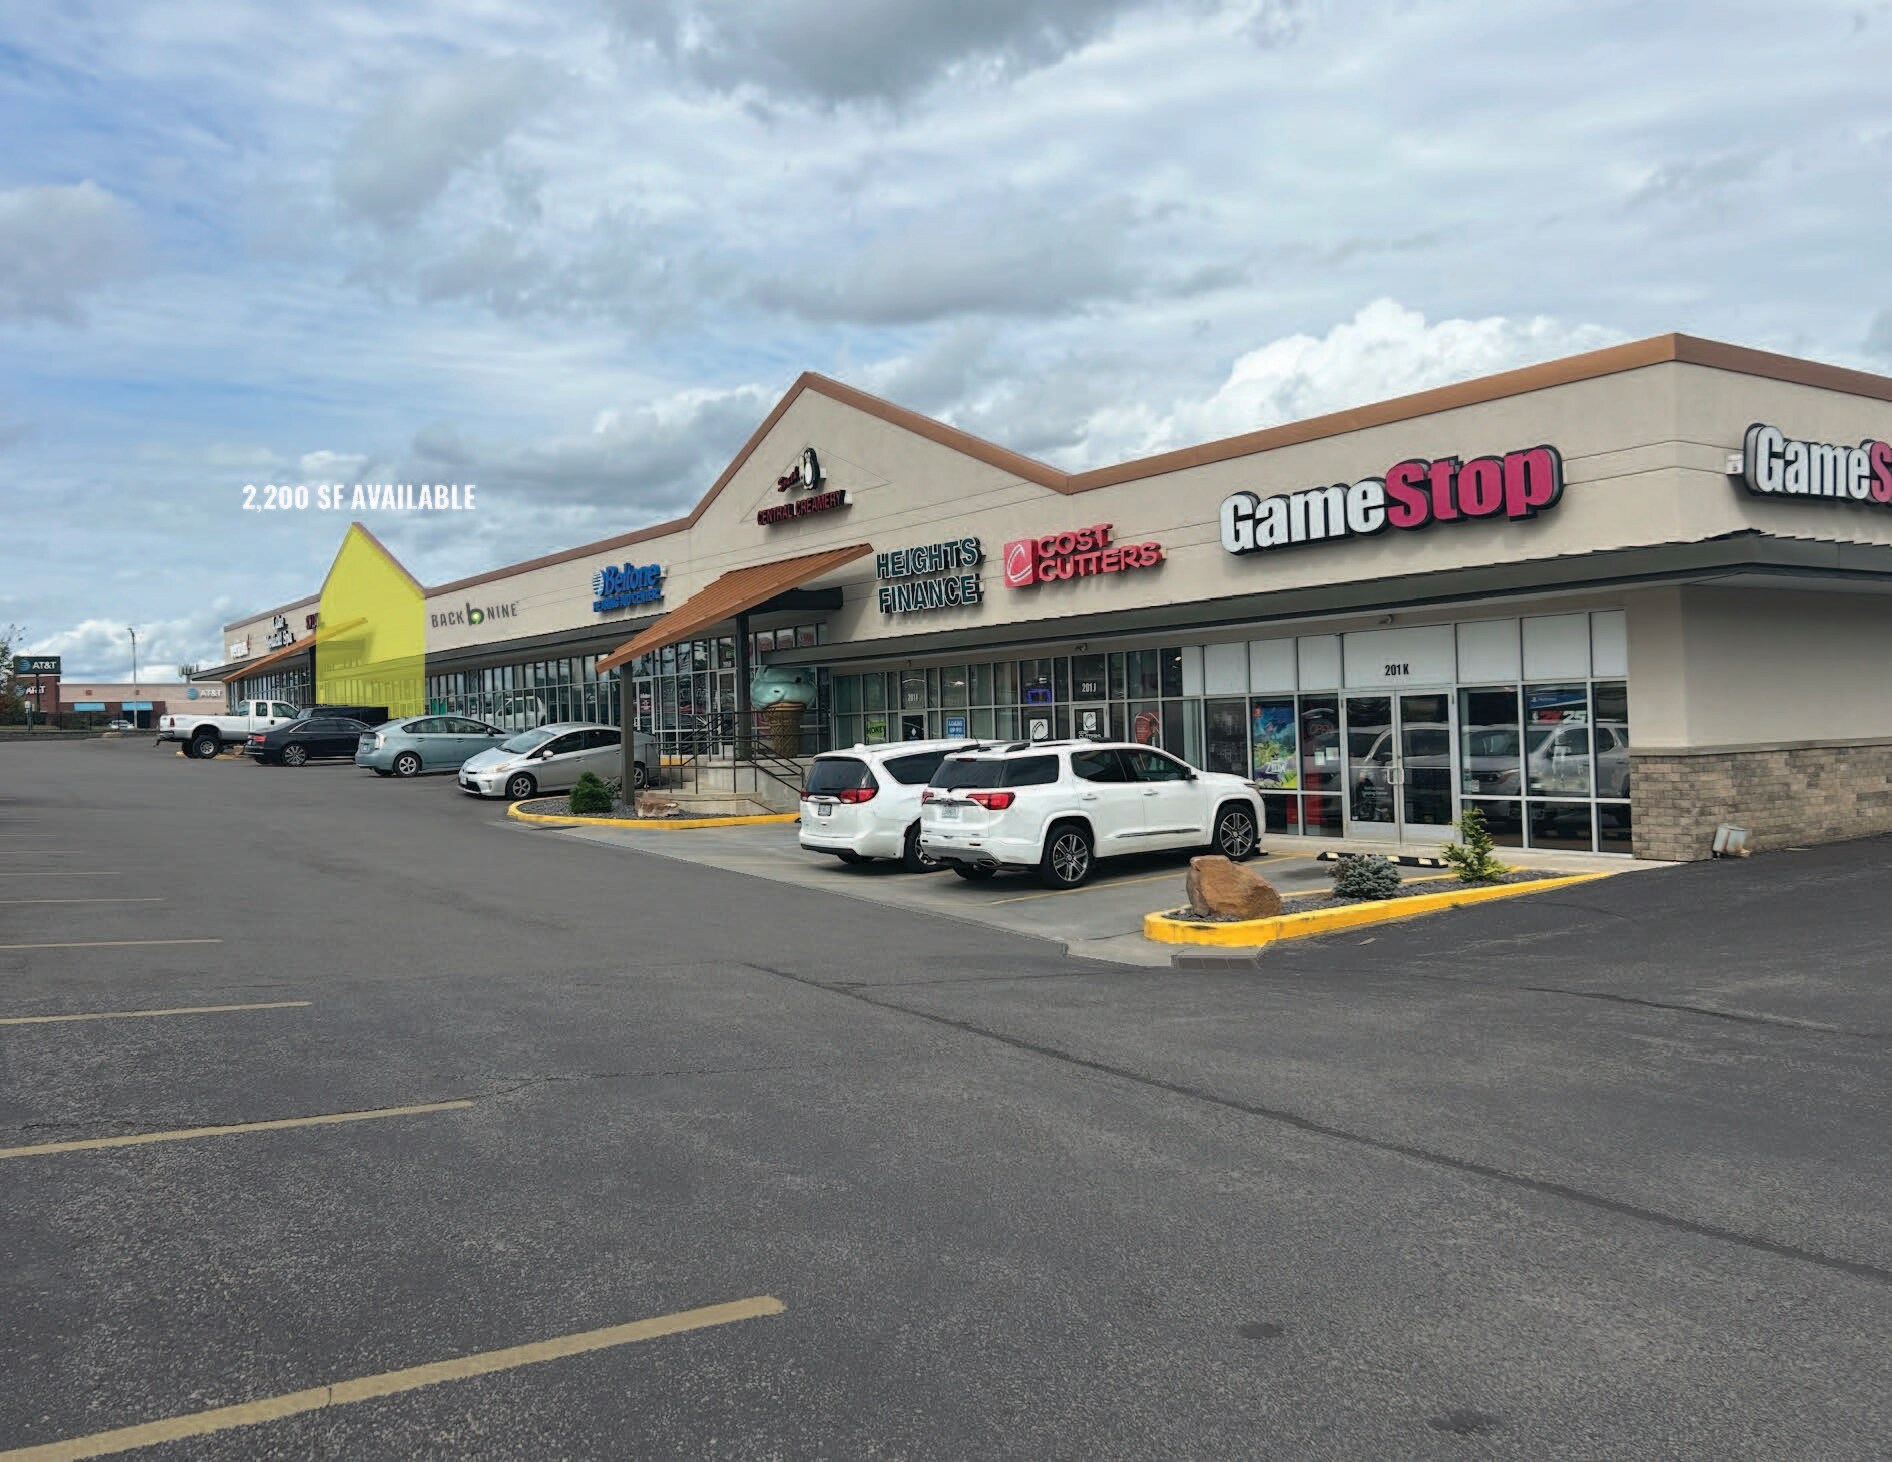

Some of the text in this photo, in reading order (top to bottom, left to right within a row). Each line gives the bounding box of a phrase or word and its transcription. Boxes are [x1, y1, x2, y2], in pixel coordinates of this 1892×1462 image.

[1219, 446, 1560, 554] GameStop
[1038, 524, 1113, 558] COST
[876, 537, 982, 580] HEIGHTS
[1038, 542, 1164, 582] CUTTERS
[601, 562, 661, 596] Beltone
[878, 574, 981, 614] FINANCE
[431, 611, 465, 628] BACK
[486, 603, 518, 620] NINE
[32, 661, 57, 670] AT&T
[1384, 664, 1409, 676] 201 K
[200, 688, 222, 697] AT&T
